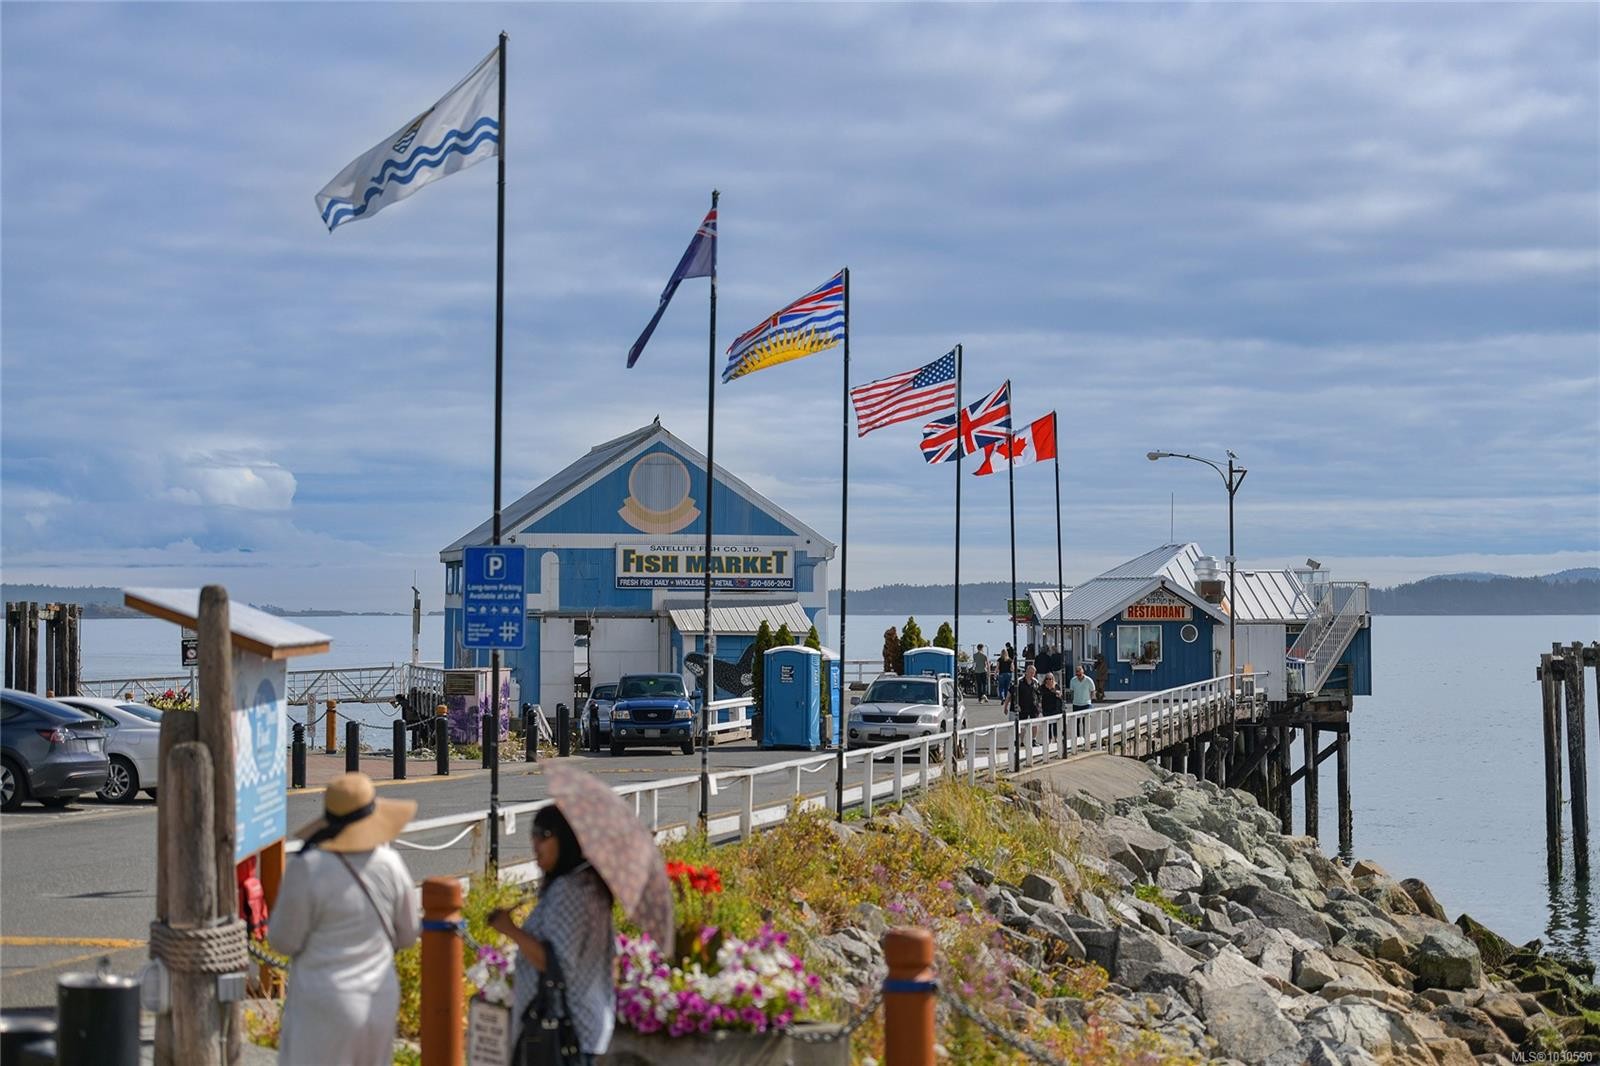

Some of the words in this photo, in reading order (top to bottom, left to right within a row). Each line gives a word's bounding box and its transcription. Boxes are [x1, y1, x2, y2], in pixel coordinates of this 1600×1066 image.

[489, 556, 503, 577] P
[622, 548, 679, 573] FISH
[499, 584, 522, 592] Parking
[469, 592, 497, 600] Available
[1127, 605, 1186, 618] RESTAURANT
